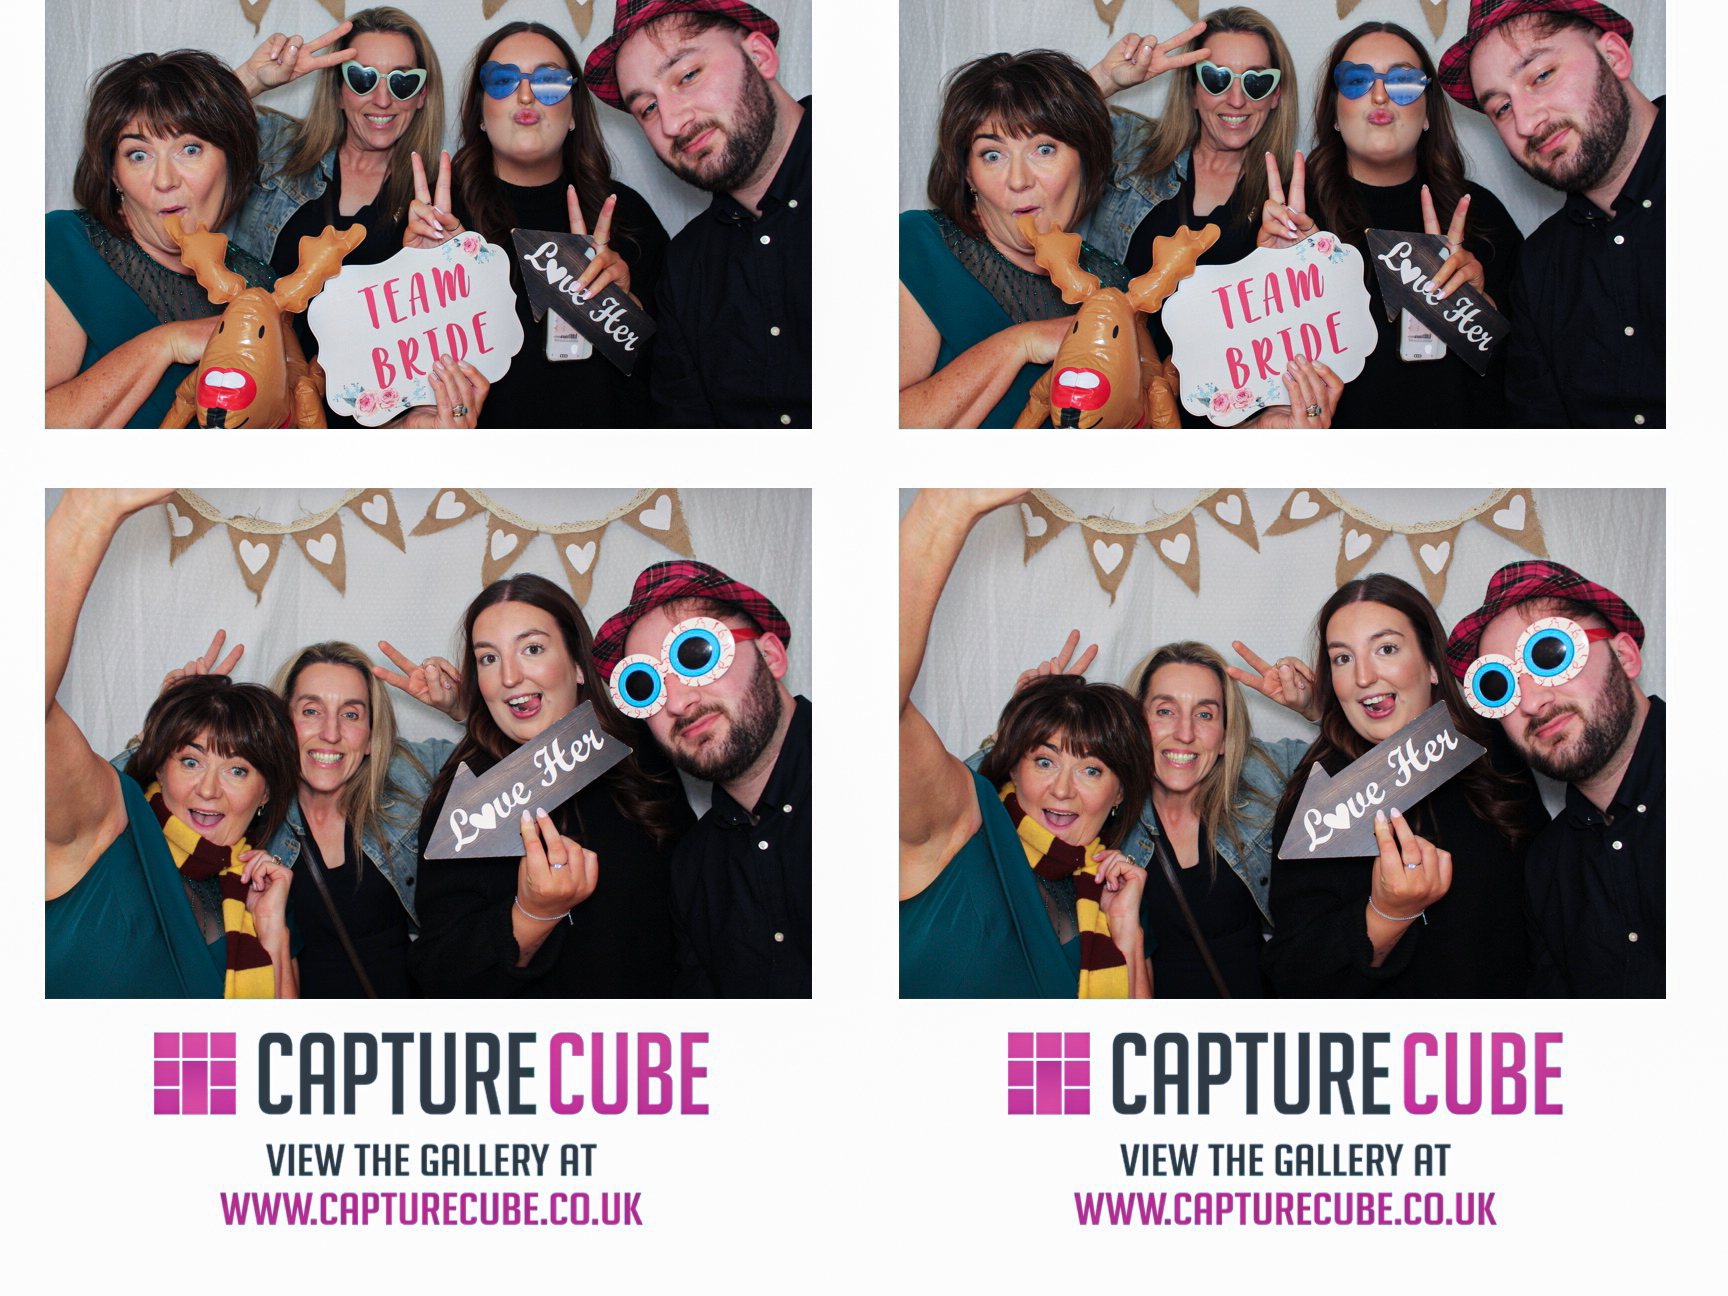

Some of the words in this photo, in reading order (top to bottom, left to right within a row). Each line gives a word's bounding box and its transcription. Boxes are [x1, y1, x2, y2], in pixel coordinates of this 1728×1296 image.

[357, 263, 471, 330] TEAM
[589, 296, 640, 352] Her
[1211, 263, 1325, 330] TEAM
[1443, 296, 1494, 352] Her
[371, 310, 495, 390] BRIDE
[1225, 310, 1349, 390] BRIDE
[533, 728, 605, 788] Her
[1387, 728, 1459, 788] Her
